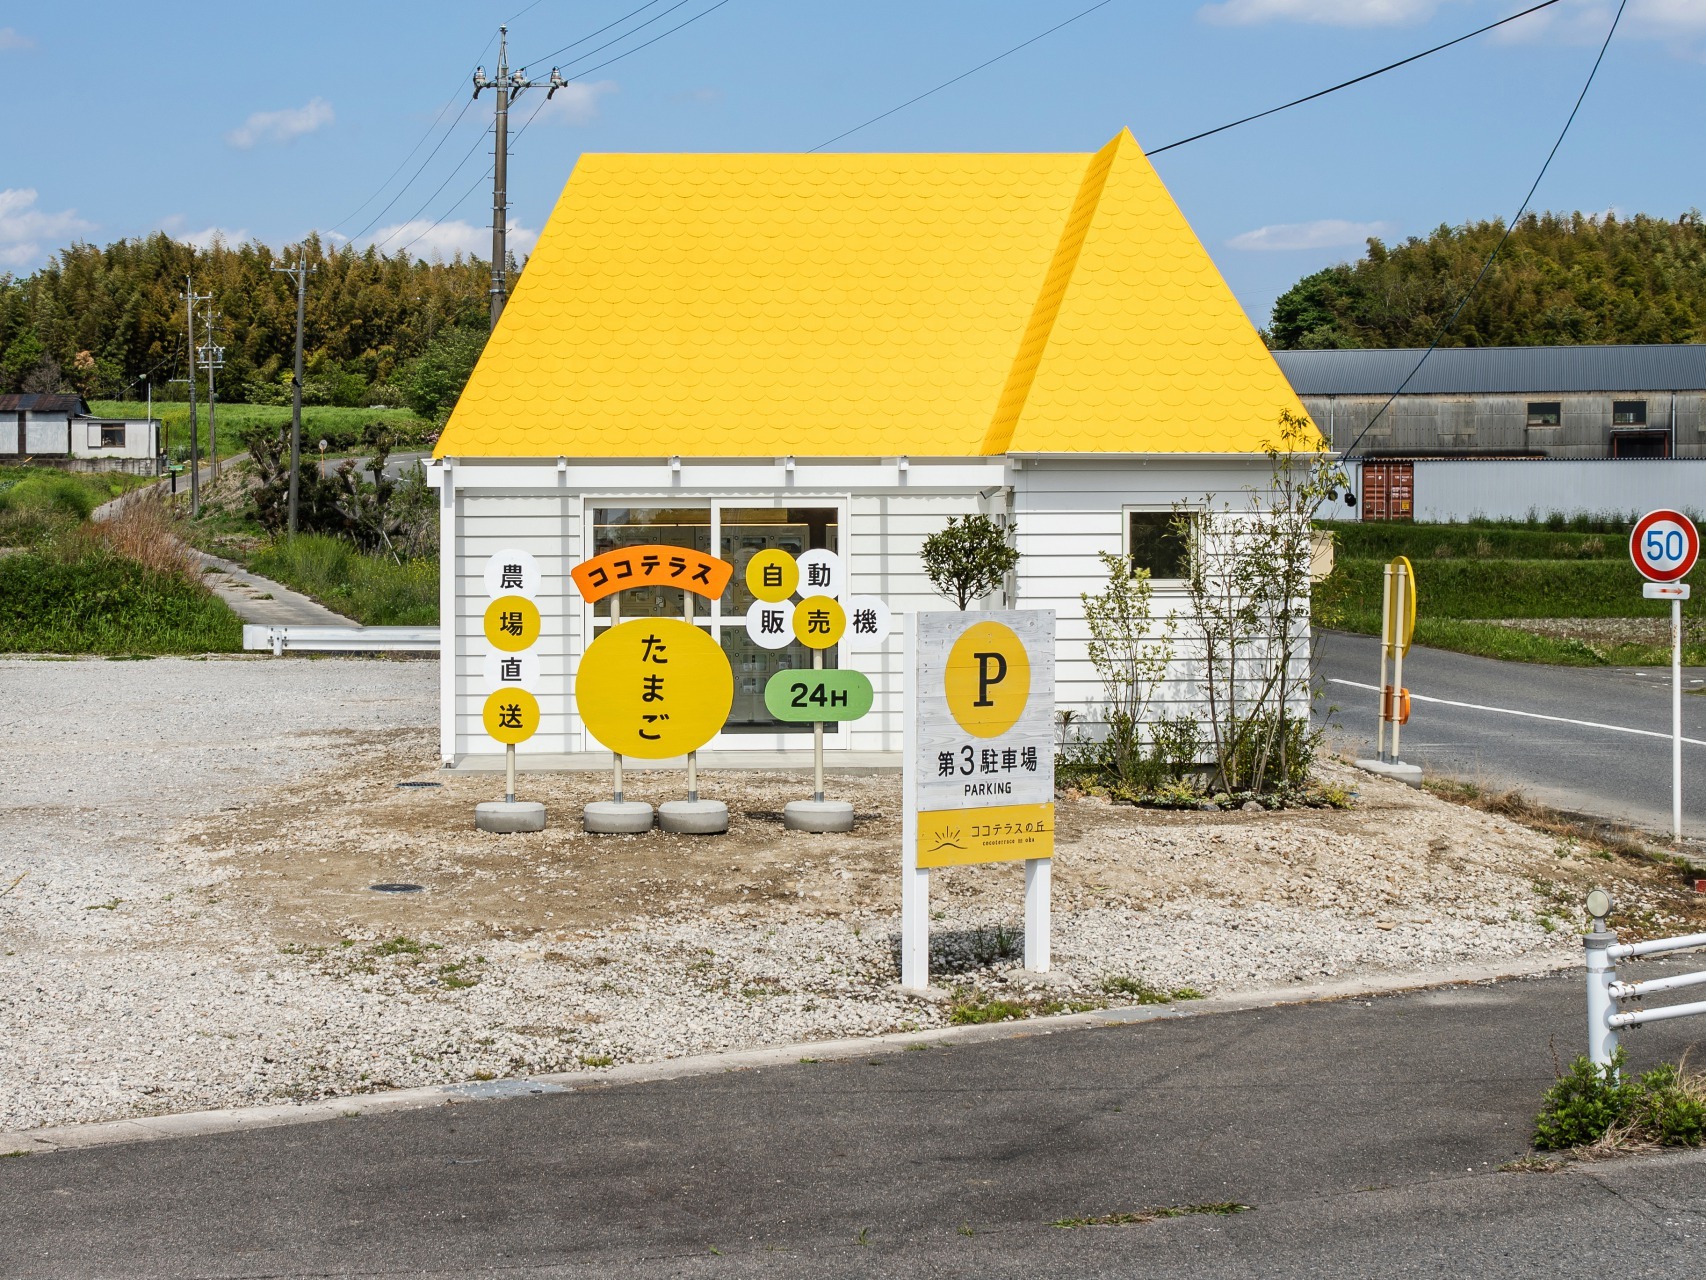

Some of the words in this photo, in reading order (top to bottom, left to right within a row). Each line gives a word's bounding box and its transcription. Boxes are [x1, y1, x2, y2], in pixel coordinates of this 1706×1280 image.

[1647, 530, 1683, 561] 50
[587, 554, 712, 587] ココテラス
[763, 562, 831, 588] 自動
[760, 608, 878, 634] 販売機
[499, 564, 524, 729] 農場直送
[638, 634, 670, 740] たまご
[790, 682, 848, 708] 24H
[973, 652, 1008, 708] P
[937, 745, 1038, 777] 第3駐車場
[964, 781, 1012, 797] PARKING
[971, 820, 1045, 838] ココテラスの丘
